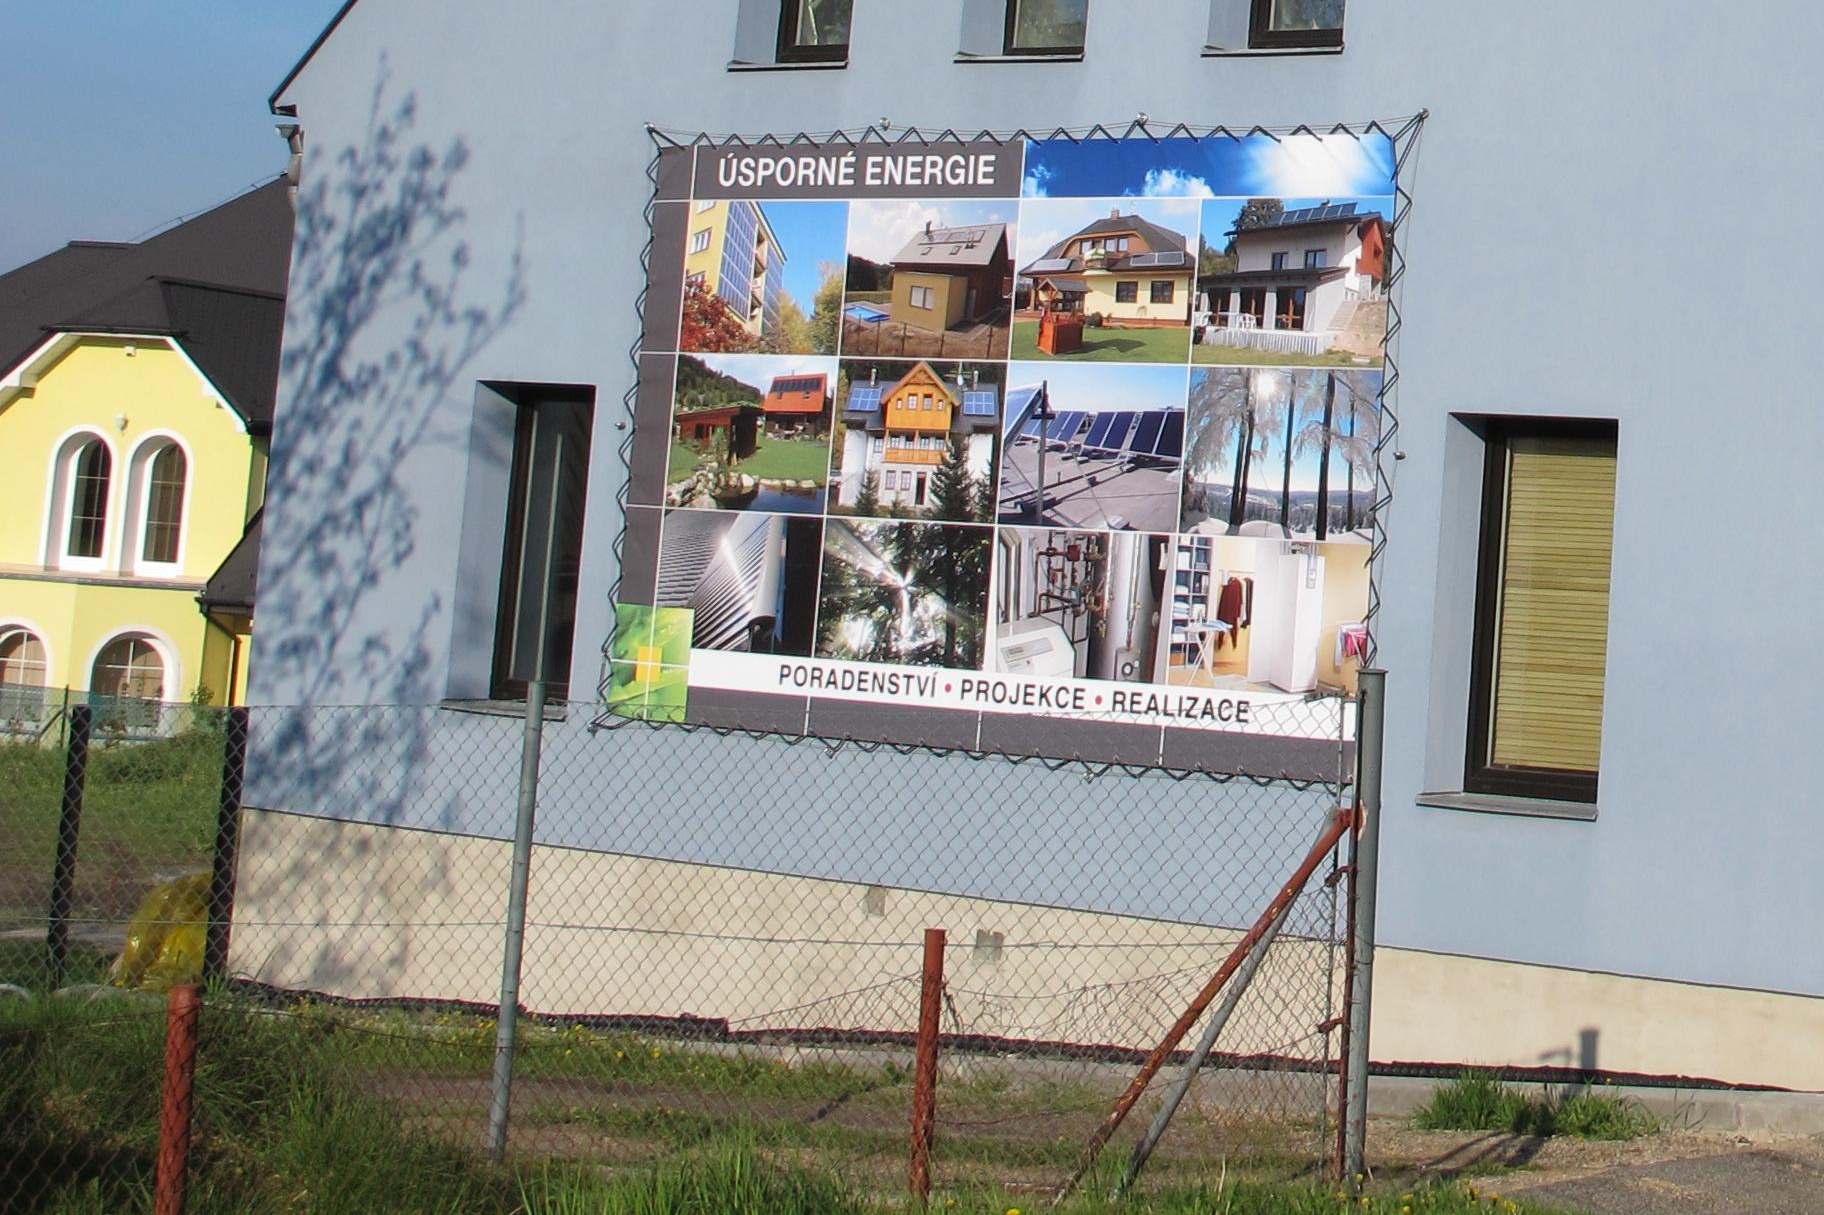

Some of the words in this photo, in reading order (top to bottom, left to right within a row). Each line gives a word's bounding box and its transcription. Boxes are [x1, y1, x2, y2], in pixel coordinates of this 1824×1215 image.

[718, 152, 857, 187] ÚSPORNÉ
[864, 154, 996, 186] ENERGIE
[779, 663, 938, 699] PORADENSTVÍ
[960, 678, 1086, 711] PROJEKCE
[1111, 690, 1251, 724] REALIZACE
